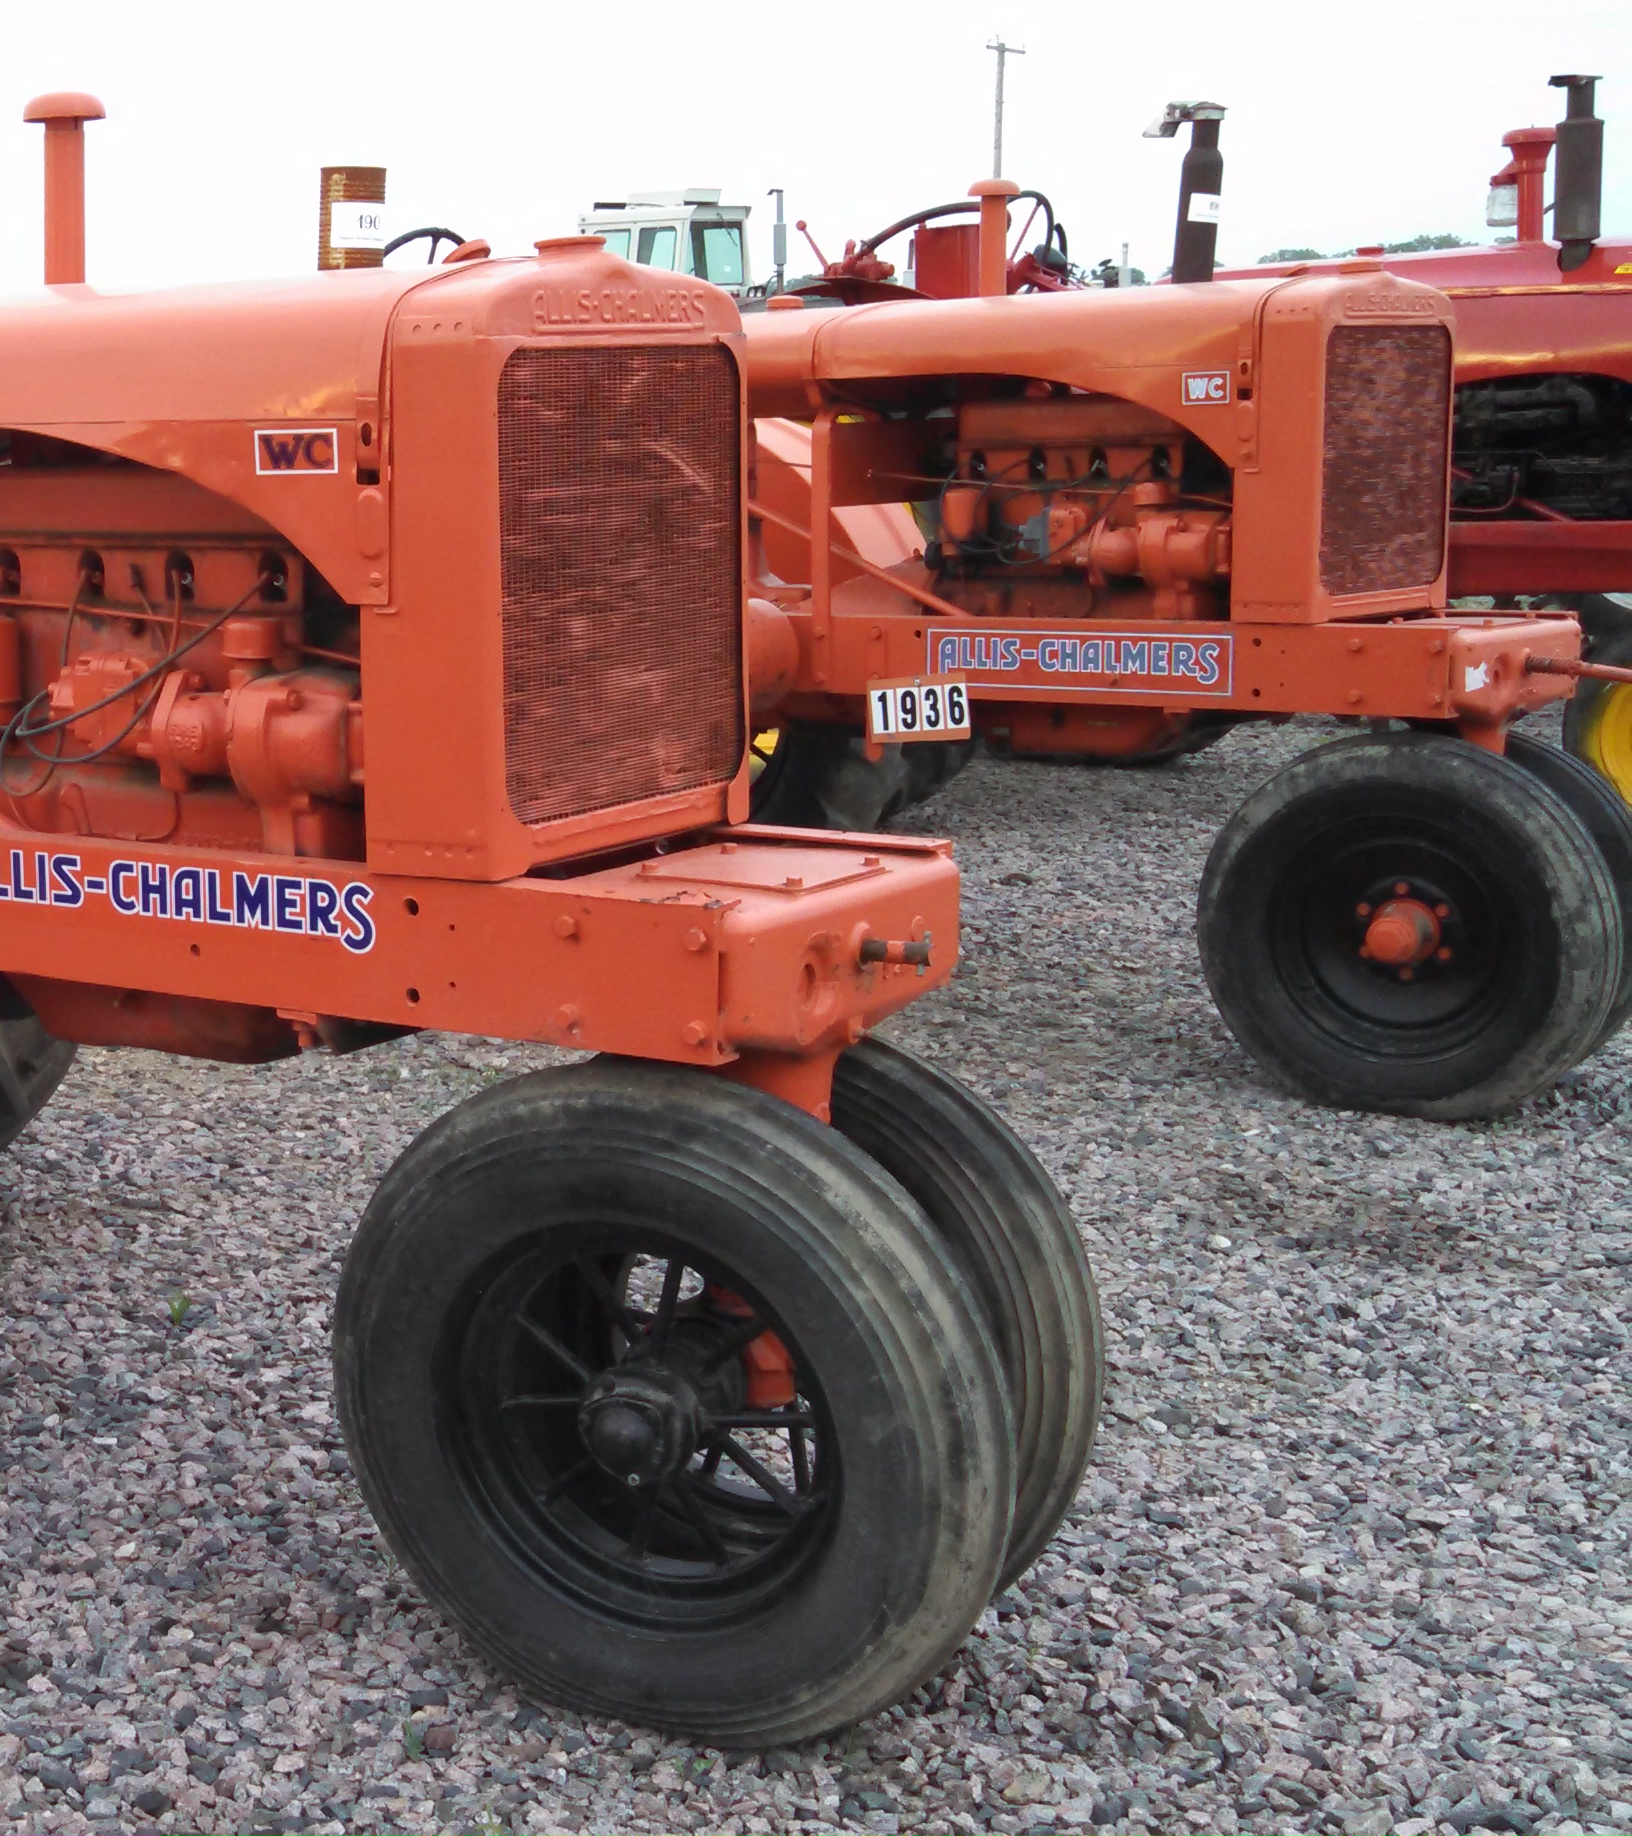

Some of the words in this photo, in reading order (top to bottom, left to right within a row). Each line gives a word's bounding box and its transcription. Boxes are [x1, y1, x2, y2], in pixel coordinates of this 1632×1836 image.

[356, 214, 381, 231] 190
[533, 289, 706, 324] ALLIS-CHALMERS
[1187, 377, 1224, 400] WC
[259, 433, 333, 469] WC
[939, 635, 1220, 686] ALLIS-CHALMERS
[876, 684, 966, 732] 1936
